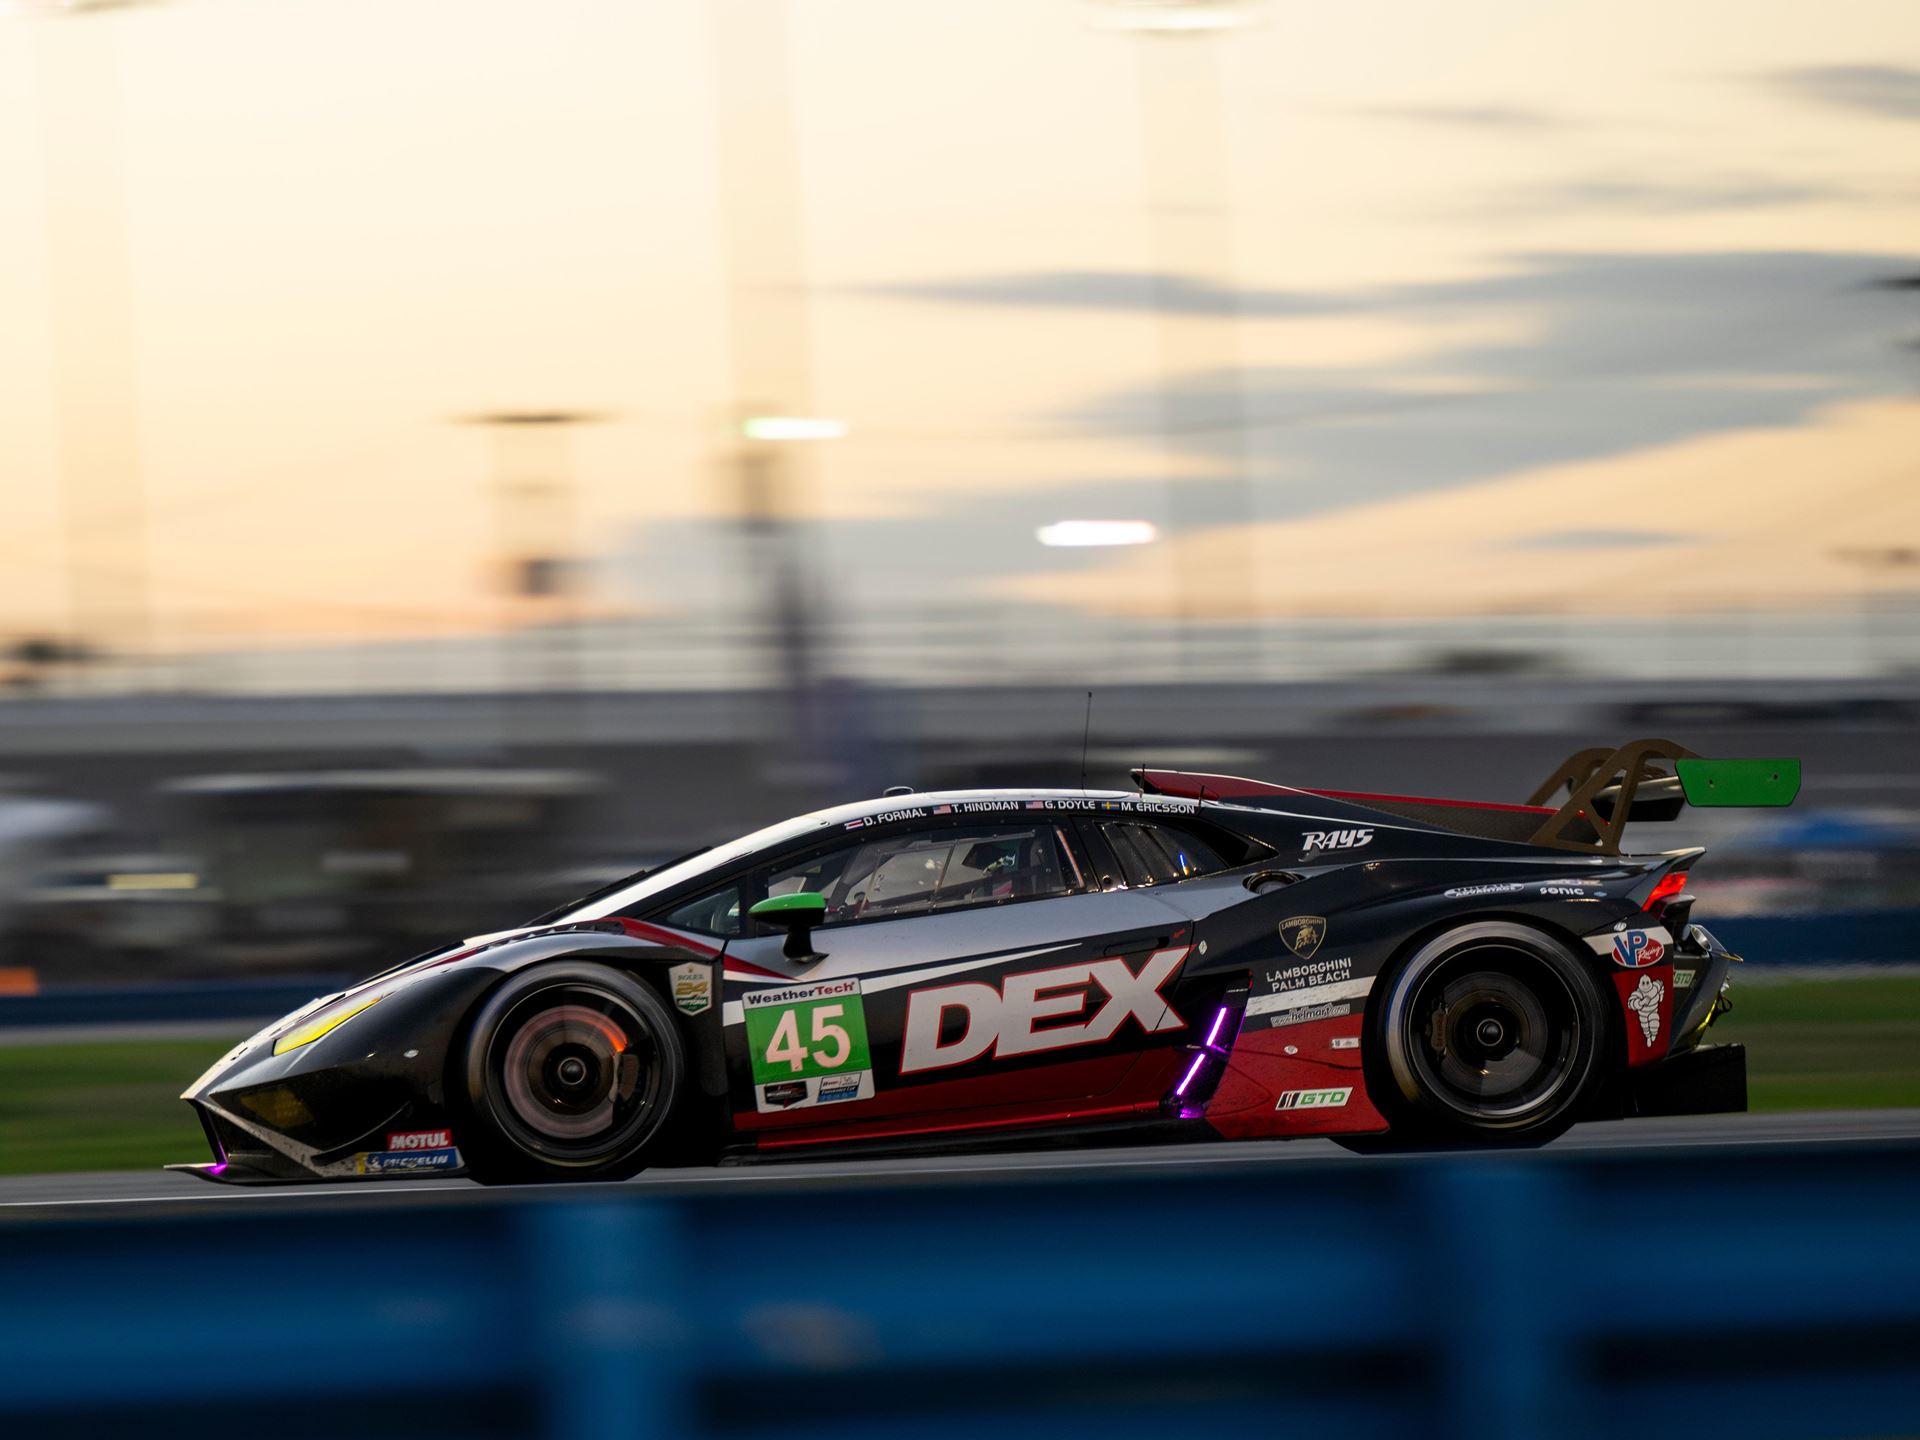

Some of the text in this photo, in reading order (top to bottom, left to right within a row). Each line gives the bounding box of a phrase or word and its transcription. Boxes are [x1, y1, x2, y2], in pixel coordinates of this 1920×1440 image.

[951, 801, 1019, 813] T. HINDMAN
[1045, 800, 1096, 810] G. DOYLE
[1121, 802, 1195, 814] M. ERICSSON
[863, 808, 927, 827] D. FORMAL
[1302, 829, 1375, 851] RAYS
[1539, 887, 1585, 896] SONIC
[1281, 918, 1323, 930] LAMBORGHINI
[1613, 930, 1649, 967] VP
[1638, 945, 1662, 962] Racing
[1265, 957, 1353, 983] LAMBORGHINI
[1271, 969, 1351, 993] PALM BEACH
[1674, 972, 1694, 986] GTD
[748, 981, 854, 1005] WeatherTech
[899, 943, 1198, 1076] DEX
[765, 1003, 852, 1073] 45
[1300, 1091, 1346, 1105] GTD
[390, 1132, 449, 1149] MOTUL
